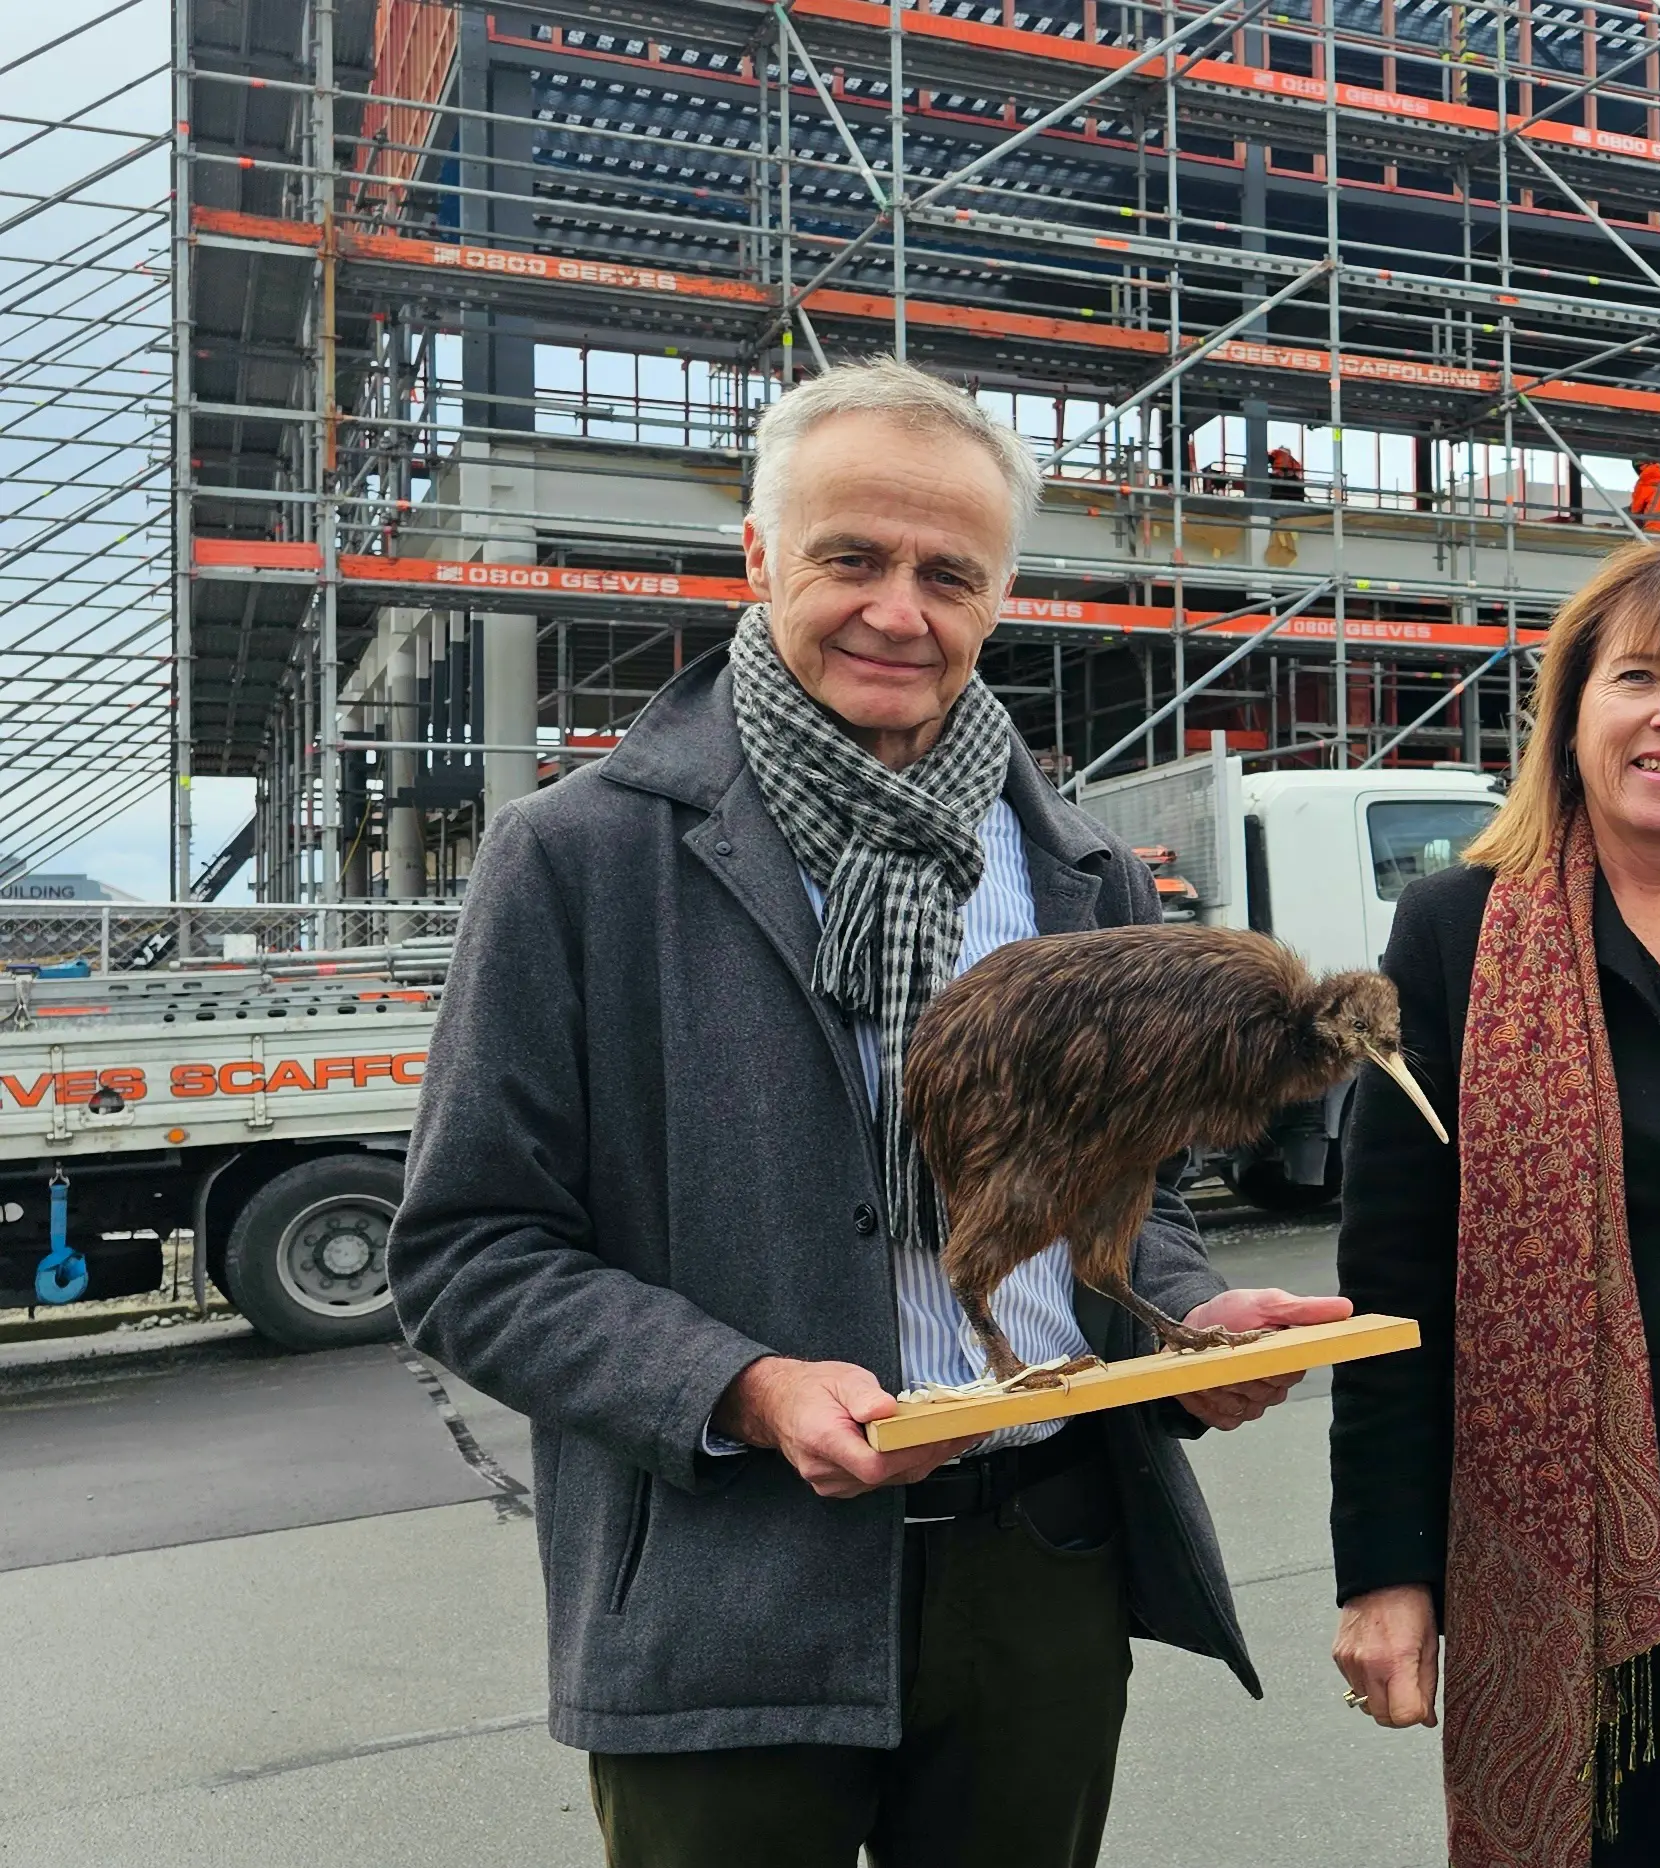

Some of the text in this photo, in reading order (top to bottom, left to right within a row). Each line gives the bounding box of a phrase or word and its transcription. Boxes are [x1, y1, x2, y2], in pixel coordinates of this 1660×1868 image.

[1345, 87, 1429, 115] GEEVES
[1597, 132, 1647, 153] 0800
[466, 251, 677, 291] 0800 GEEVES
[1230, 344, 1322, 369] GEEVES
[469, 567, 680, 595] 0800 GEEVES
[1001, 600, 1083, 618] EEVES
[1346, 623, 1432, 638] GEEVES
[0, 1052, 429, 1108] VES SCAFFO
